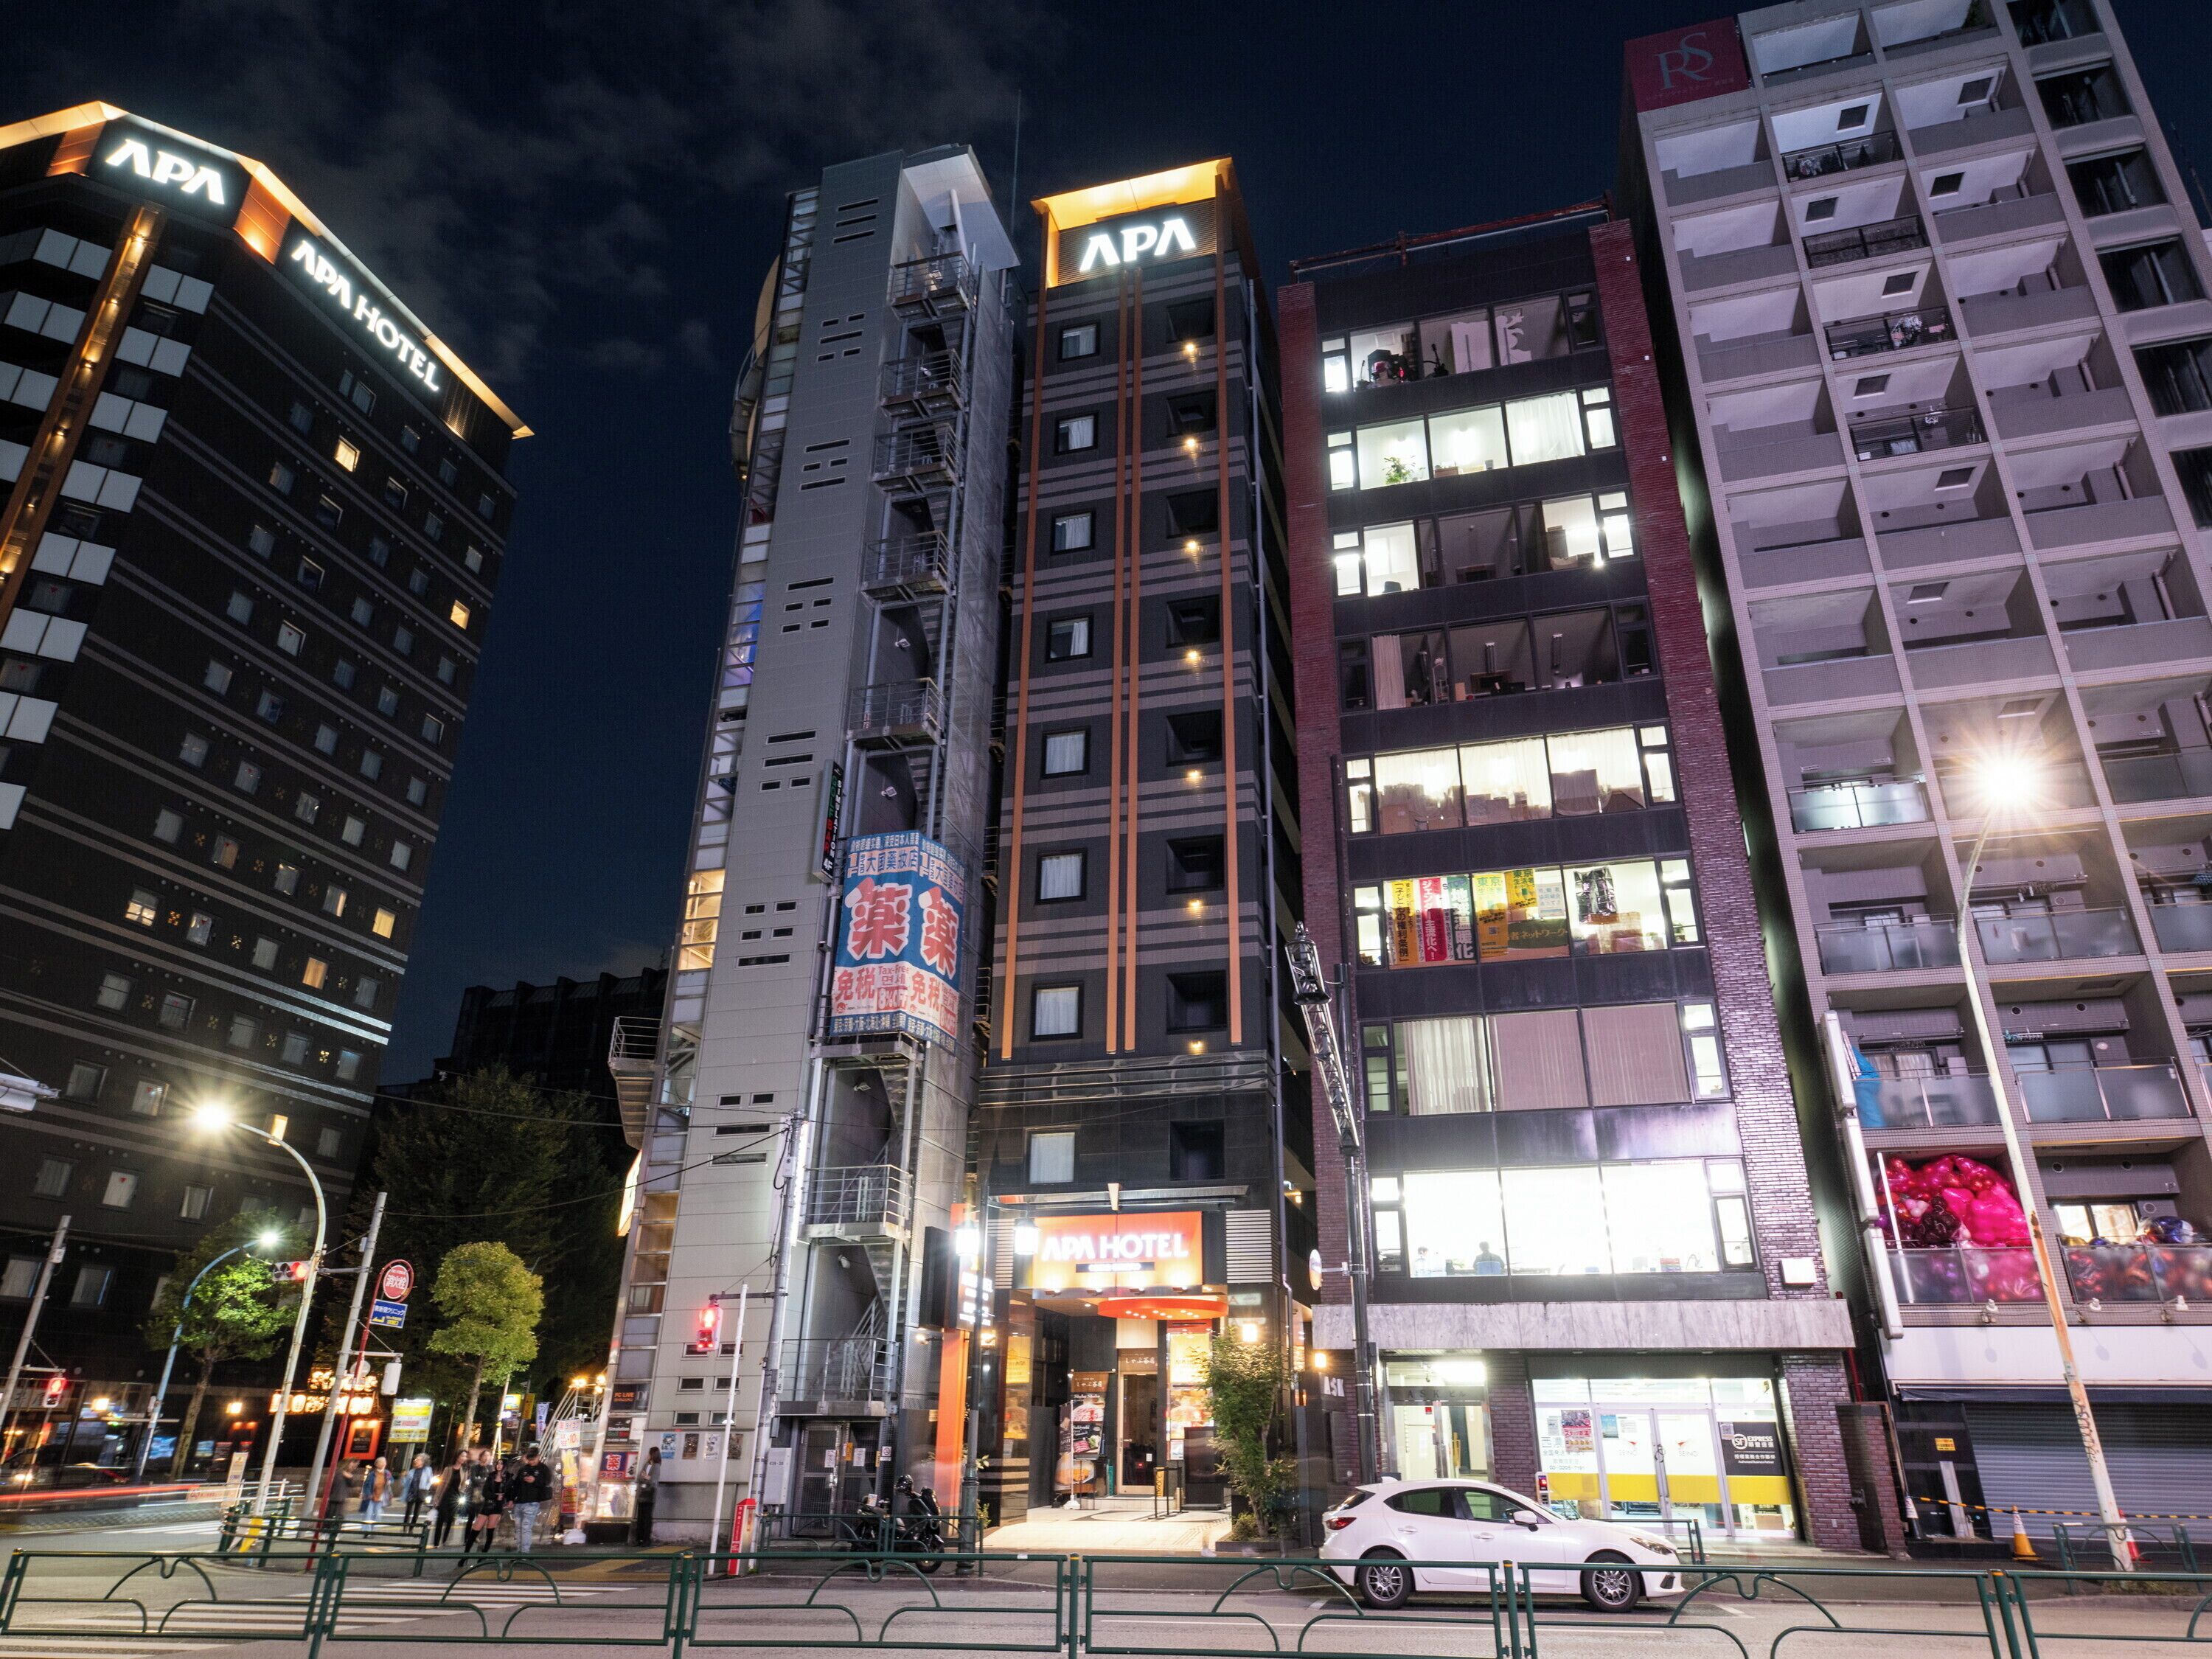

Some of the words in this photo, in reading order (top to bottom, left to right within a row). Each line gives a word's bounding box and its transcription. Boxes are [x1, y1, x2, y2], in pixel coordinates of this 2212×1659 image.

[105, 139, 226, 205] APA
[1079, 218, 1197, 273] APA
[291, 240, 351, 308] APA
[353, 294, 439, 392] HOTEL
[829, 779, 843, 858] SIMULATION
[824, 858, 833, 871] 4F
[1513, 869, 1534, 879] 東京
[1477, 877, 1501, 887] 東京
[835, 967, 876, 1001] 免税
[878, 964, 909, 975] Tax-Free
[911, 971, 941, 1012] 免税
[1041, 1235, 1096, 1261] APA
[1099, 1233, 1189, 1259] HOTEL
[385, 1274, 407, 1290] 消火栓
